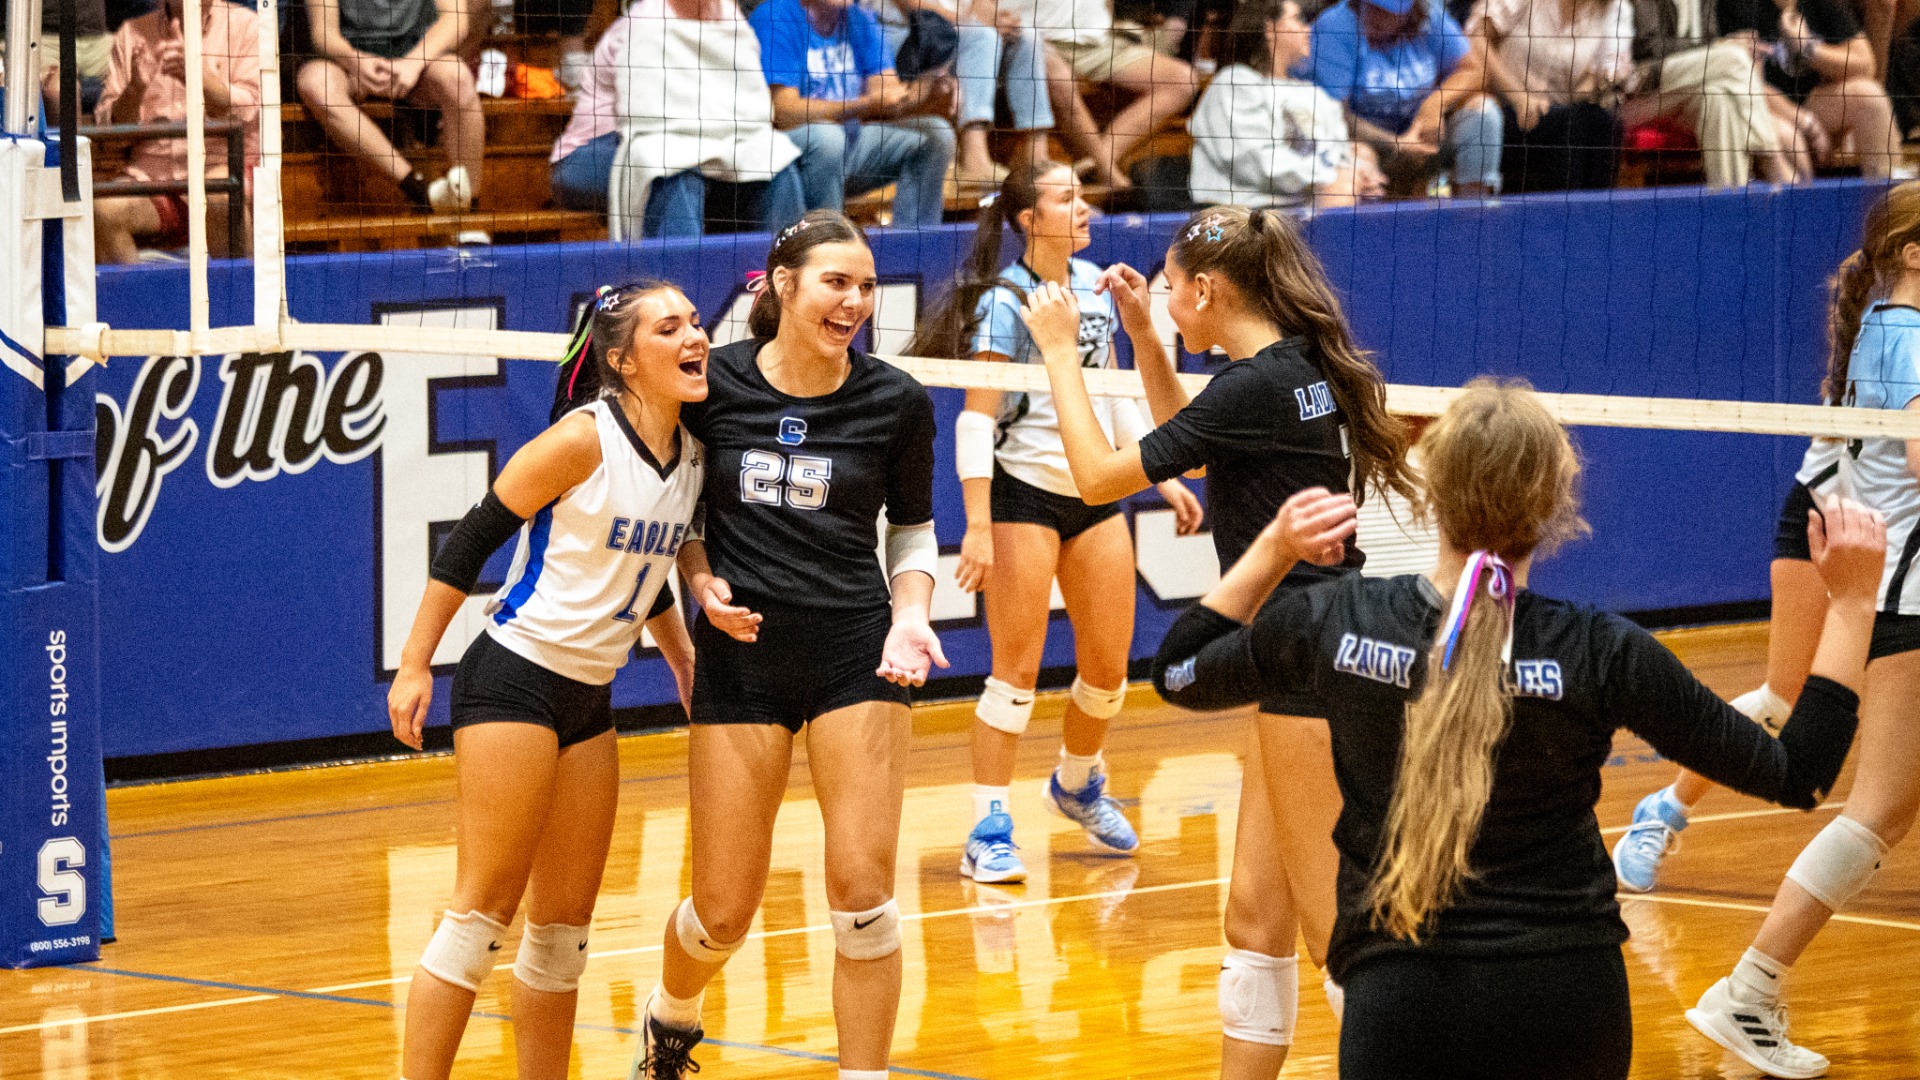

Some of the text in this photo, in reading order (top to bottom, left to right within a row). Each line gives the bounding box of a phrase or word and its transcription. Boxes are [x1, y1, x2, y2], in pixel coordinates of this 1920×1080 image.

[206, 350, 388, 489] the
[776, 416, 808, 446] S
[740, 448, 832, 510] 25
[612, 562, 652, 624] 1
[1334, 632, 1416, 689] LADY
[45, 629, 71, 827] sports imports
[37, 836, 86, 927] S
[30, 935, 91, 953] (800) 556-3198
